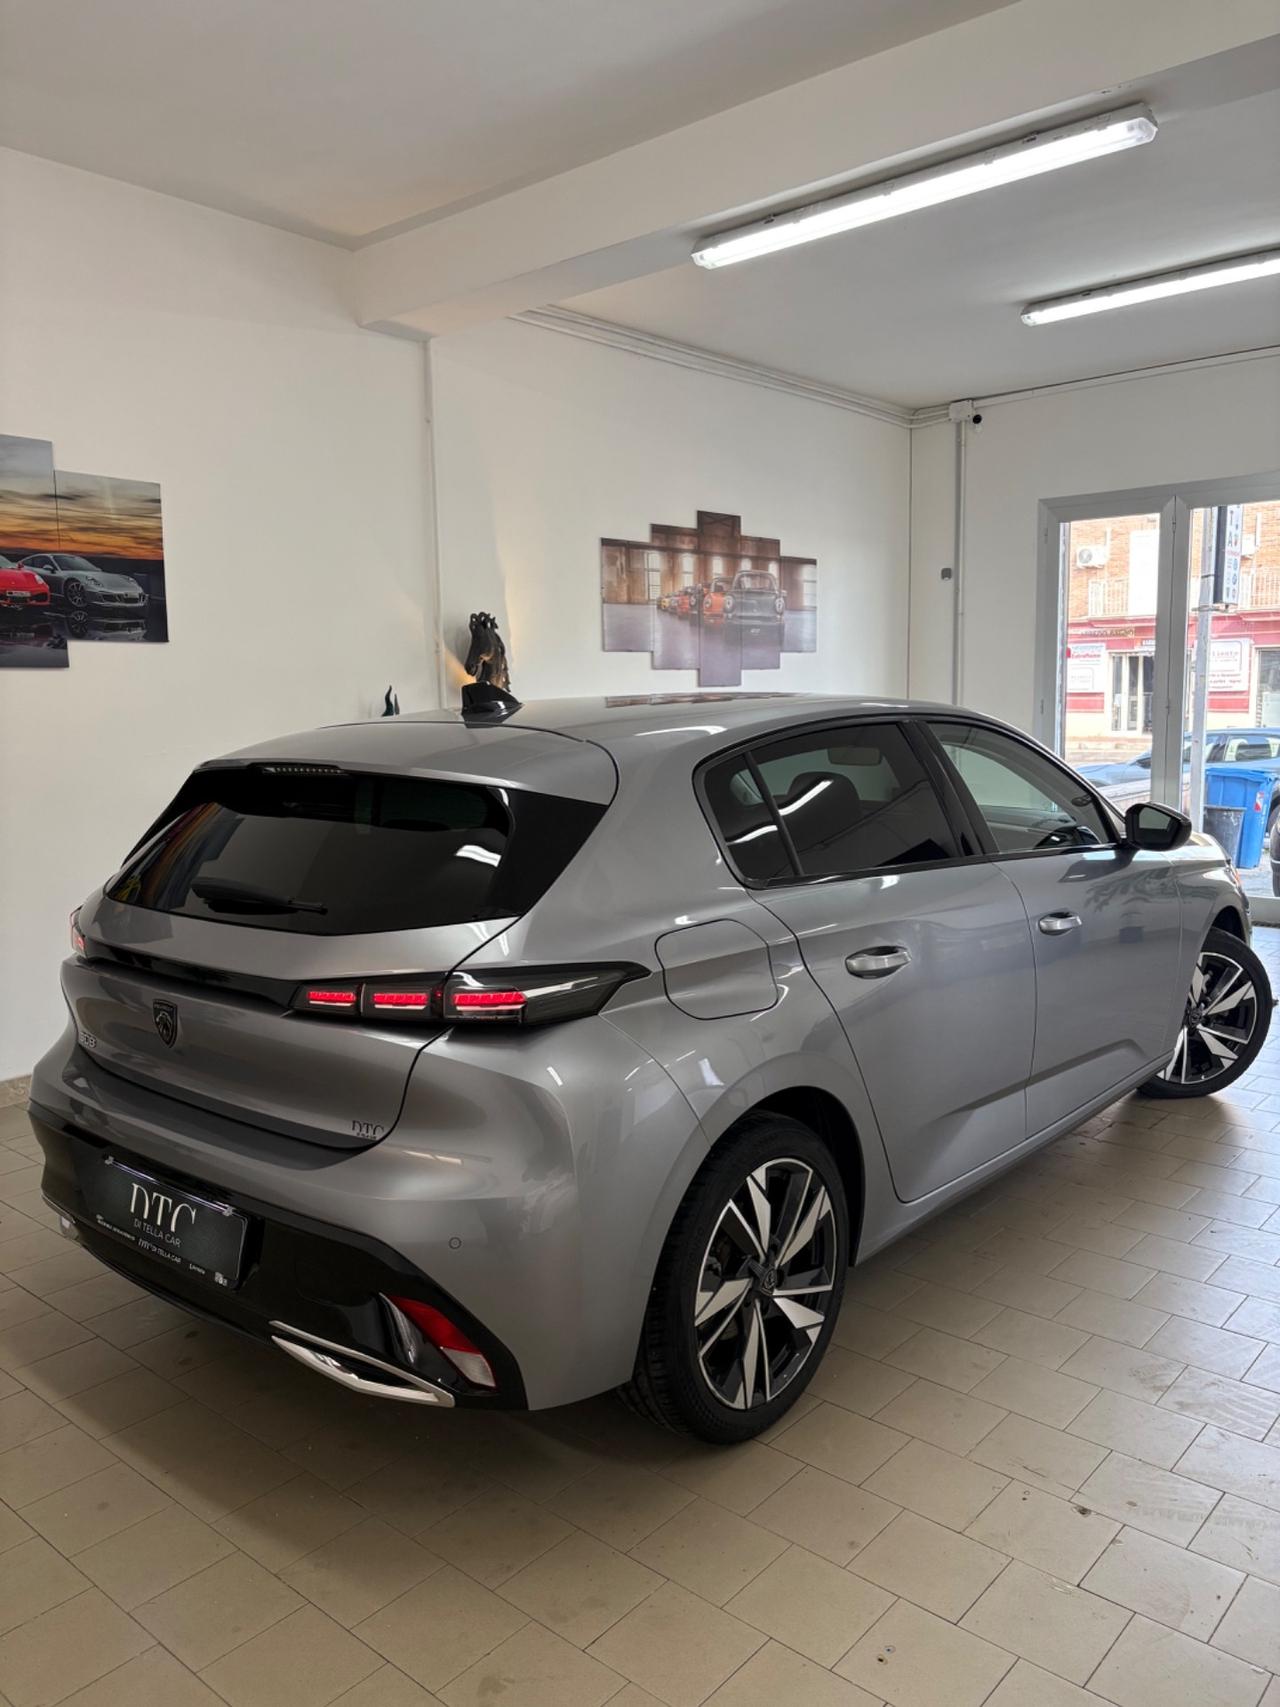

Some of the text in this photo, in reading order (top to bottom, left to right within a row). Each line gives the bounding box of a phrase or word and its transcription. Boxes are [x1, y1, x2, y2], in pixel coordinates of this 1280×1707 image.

[352, 1120, 385, 1135] DTC
[130, 1182, 197, 1233] DTC
[134, 1218, 141, 1230] DI
[142, 1222, 164, 1240] TELLA
[165, 1233, 182, 1248] CAR
